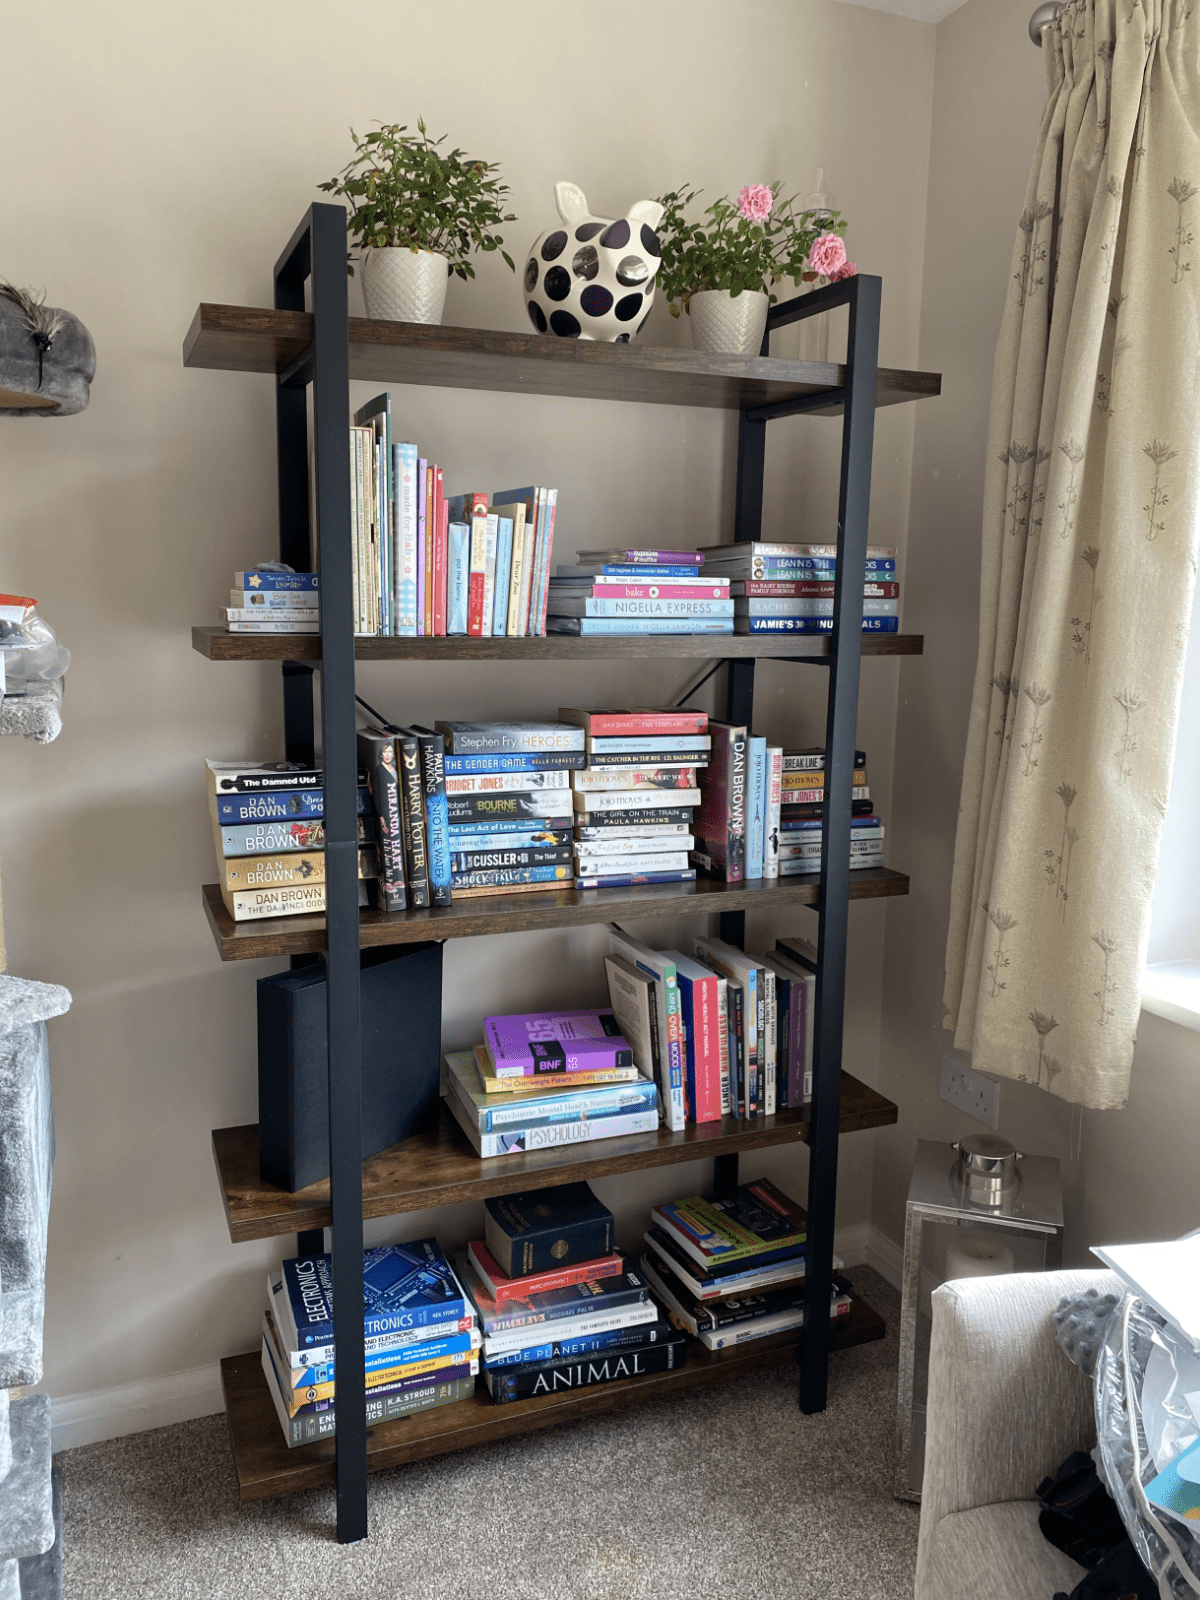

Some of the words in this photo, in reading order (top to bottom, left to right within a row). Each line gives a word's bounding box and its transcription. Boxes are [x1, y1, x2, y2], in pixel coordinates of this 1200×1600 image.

[403, 486, 412, 512] made
[404, 514, 412, 532] for
[402, 533, 412, 562] Baby
[778, 558, 796, 568] LEAN
[798, 559, 804, 568] IN
[806, 560, 812, 568] 15
[777, 570, 796, 579] LEAN
[798, 570, 804, 579] IN
[626, 586, 644, 597] bake
[616, 602, 662, 613] NIGELLA
[667, 602, 712, 614] EXPRESS
[754, 620, 794, 629] JAMIE'S
[461, 736, 500, 750] Stephen
[502, 736, 517, 748] Fry
[522, 736, 570, 747] HEROES
[446, 760, 462, 770] THE
[465, 759, 498, 769] GENDER
[502, 758, 527, 768] GAME
[734, 742, 744, 773] DAN
[785, 758, 804, 768] BREAK
[806, 757, 818, 768] LINE
[424, 745, 436, 793] HAWKINS
[434, 753, 444, 784] PAULA
[262, 778, 298, 786] Damned
[300, 776, 316, 784] Utd
[478, 777, 504, 790] JONES
[250, 797, 276, 807] DAN
[408, 774, 422, 818] HARRY
[599, 798, 615, 808] jojo
[616, 796, 642, 806] moyes
[732, 775, 744, 828] BROWN
[240, 804, 286, 818] BROWN
[387, 782, 400, 838] MIRANDA
[477, 800, 518, 810] BOURNE
[256, 825, 286, 836] DAN
[433, 828, 442, 846] THE
[245, 834, 300, 850] BROWN
[410, 820, 425, 871] POTTER
[392, 839, 402, 871] HART
[474, 853, 517, 866] CUSSLER
[257, 862, 283, 872] DAN
[434, 847, 444, 880] WATER
[247, 868, 294, 884] BROWN
[455, 874, 488, 885] SHOCK
[495, 871, 514, 882] FALL
[256, 894, 278, 905] DAN
[281, 888, 322, 902] BROWN
[248, 906, 264, 914] THE
[668, 992, 677, 1014] MIND
[669, 1015, 678, 1041] OVER
[720, 1014, 728, 1072] MINDFULNESS
[670, 1042, 679, 1068] MOOD
[540, 1060, 562, 1070] BNF
[721, 1076, 730, 1109] LANGER
[494, 1108, 535, 1122] Psychiatric
[538, 1106, 562, 1117] Mental
[590, 1098, 618, 1109] Nursing
[530, 1121, 592, 1146] PSYCHOLOGY
[295, 1260, 328, 1322] ELECTRONICS
[550, 1310, 576, 1320] MICHAEL
[577, 1305, 595, 1315] PALIN
[426, 1325, 440, 1333] JOHN
[492, 1314, 546, 1332] HIMALAYA
[377, 1335, 418, 1349] TECHNOLOGY
[378, 1330, 416, 1342] ELECTRONIC
[498, 1350, 530, 1364] BLUE
[536, 1343, 586, 1360] PLANET
[592, 1341, 600, 1350] II
[320, 1370, 326, 1378] 3
[532, 1354, 646, 1395] ANIMAL
[388, 1396, 404, 1406] K.A.
[404, 1387, 436, 1401] STROUD
